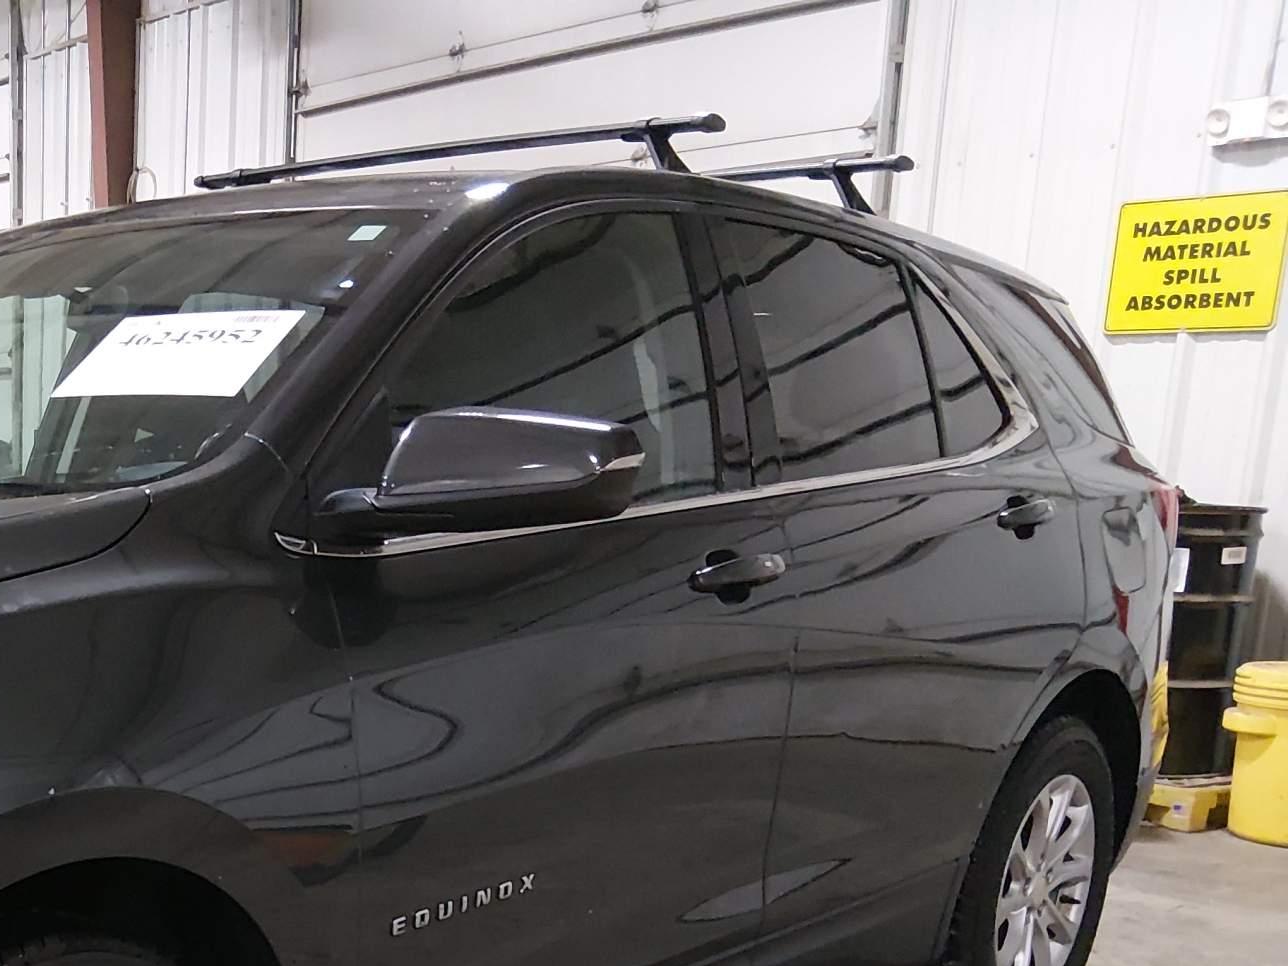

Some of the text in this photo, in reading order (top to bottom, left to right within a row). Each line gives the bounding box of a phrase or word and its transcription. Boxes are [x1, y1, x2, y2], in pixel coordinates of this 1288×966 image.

[1133, 213, 1272, 238] HAZARDOUS
[1142, 240, 1251, 262] MATERIAL
[1162, 267, 1222, 286] SPILL
[1125, 291, 1256, 311] ABSORBENT
[120, 329, 263, 346] 46245952
[391, 873, 535, 936] EQUINOX
